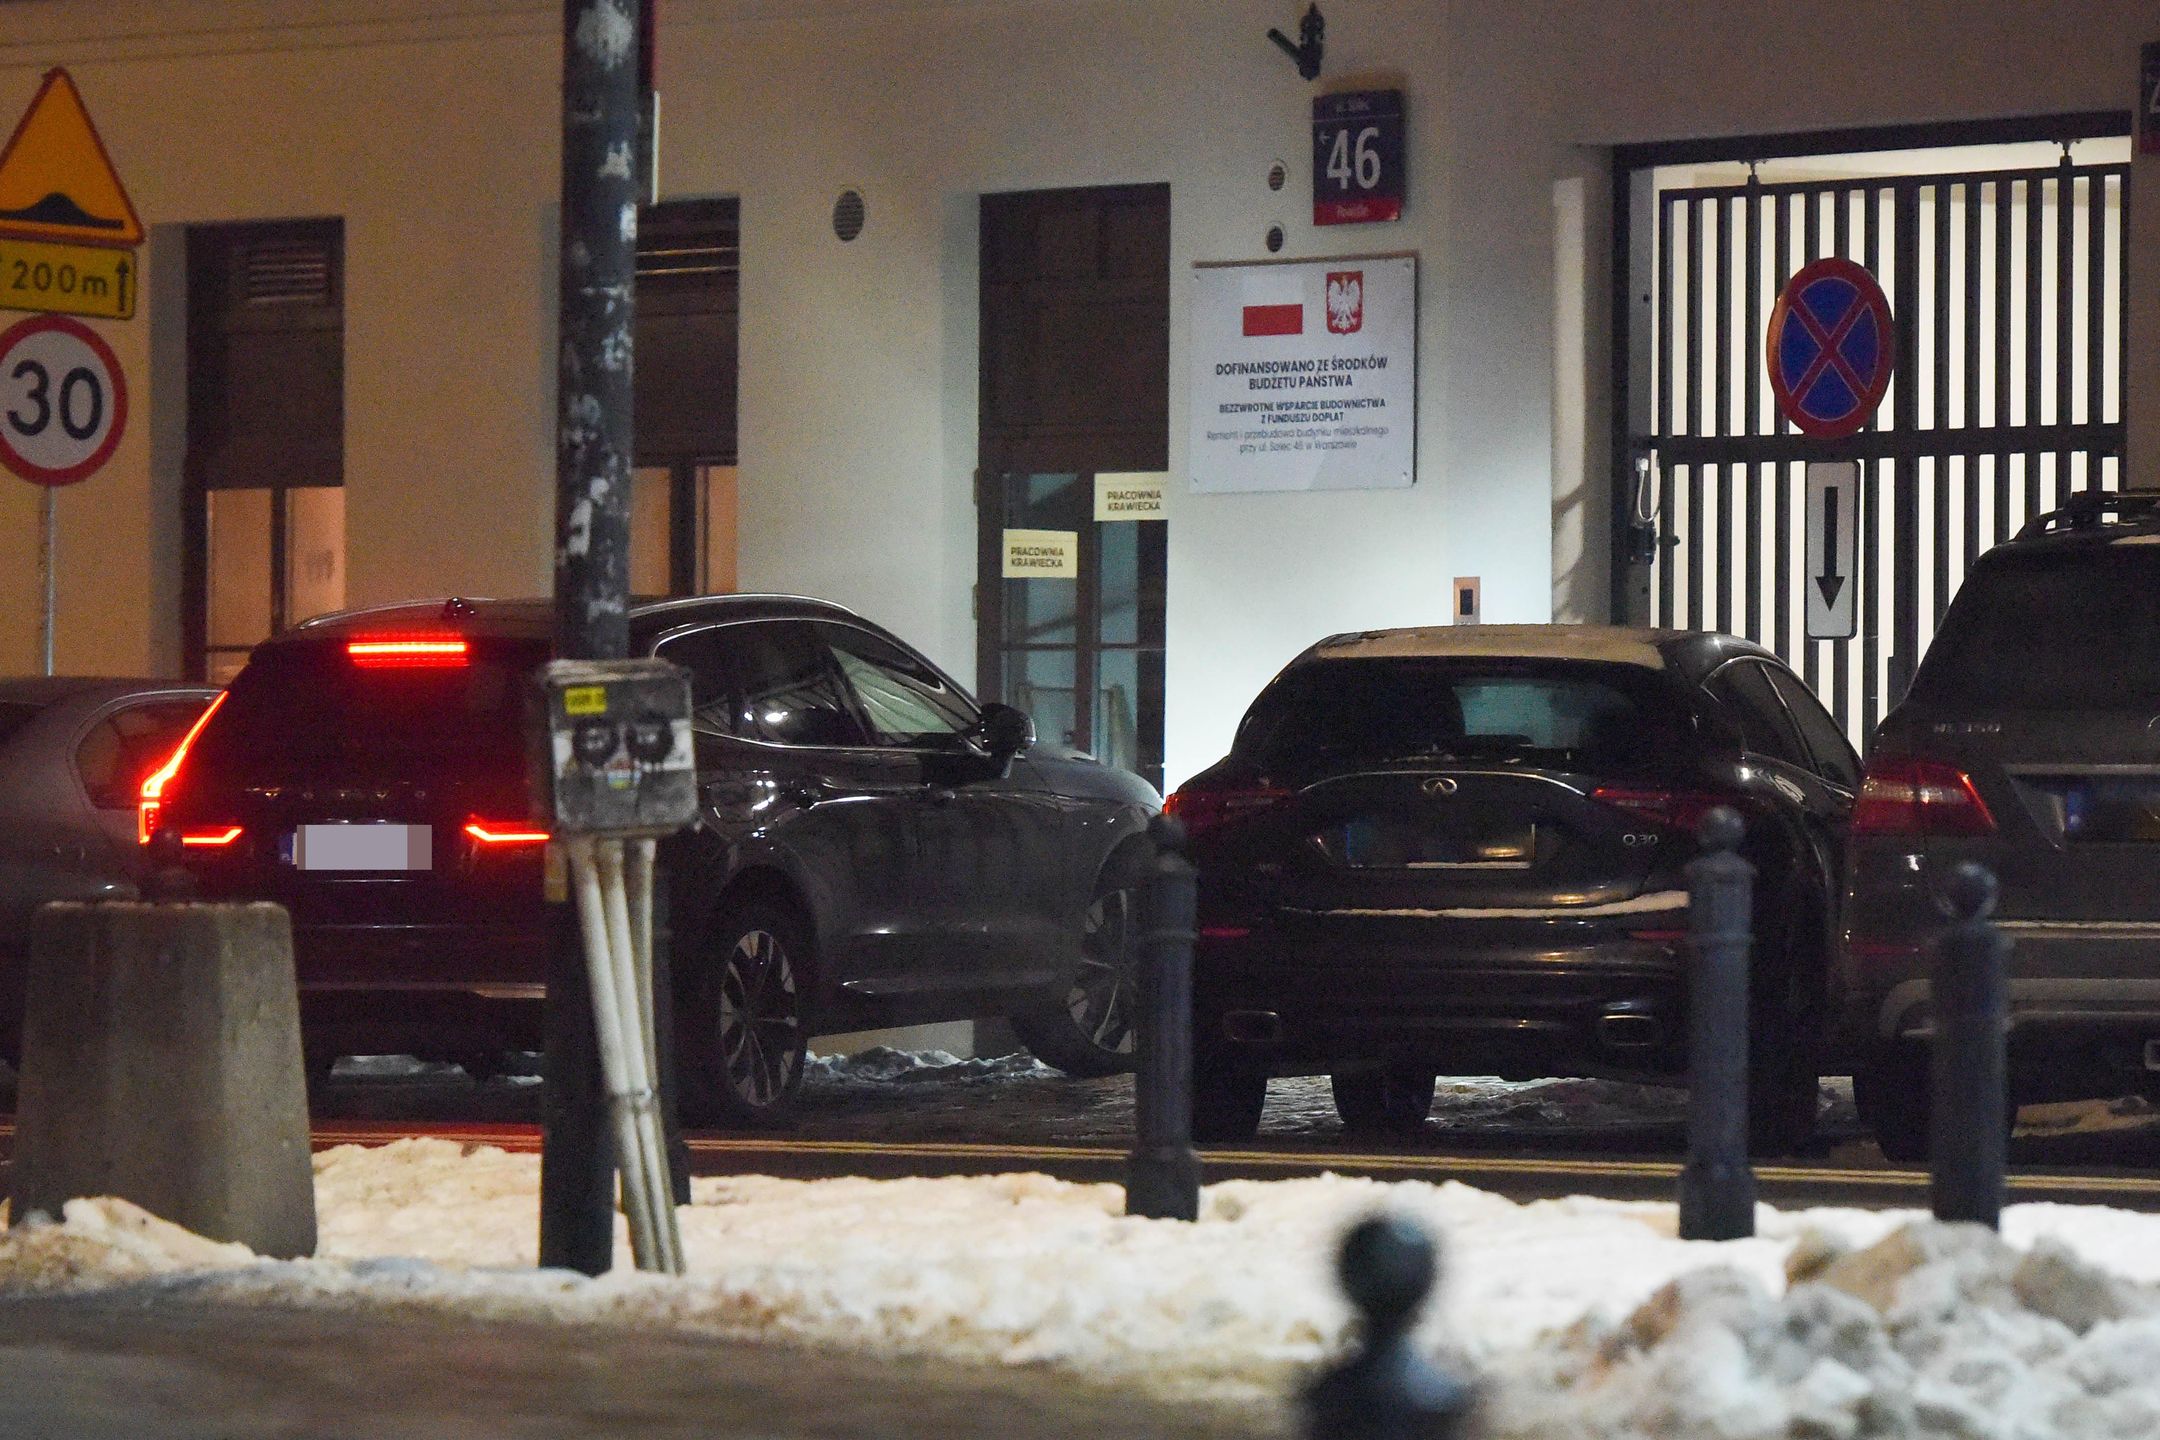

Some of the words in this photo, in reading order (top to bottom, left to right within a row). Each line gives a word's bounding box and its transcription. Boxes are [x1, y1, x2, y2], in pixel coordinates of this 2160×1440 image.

[1326, 126, 1382, 190] 46
[1216, 360, 1314, 375] DOFINANSOWANO
[1317, 359, 1329, 371] ZE
[1331, 354, 1388, 371] ŚRODKÓW
[7, 359, 103, 441] 30
[1219, 402, 1274, 413] BEZZWROTNE
[1276, 400, 1318, 411] WSPARCIE
[1320, 399, 1386, 410] BUDOWNICTWA
[1261, 414, 1266, 424] Z
[1268, 413, 1311, 423] FUNDUSZU
[1108, 490, 1161, 500] PRACOWNIA
[1108, 501, 1161, 511] KRAWIECKA
[1011, 547, 1064, 557] PRACOWNIA
[1011, 558, 1063, 568] KRAWIECKA
